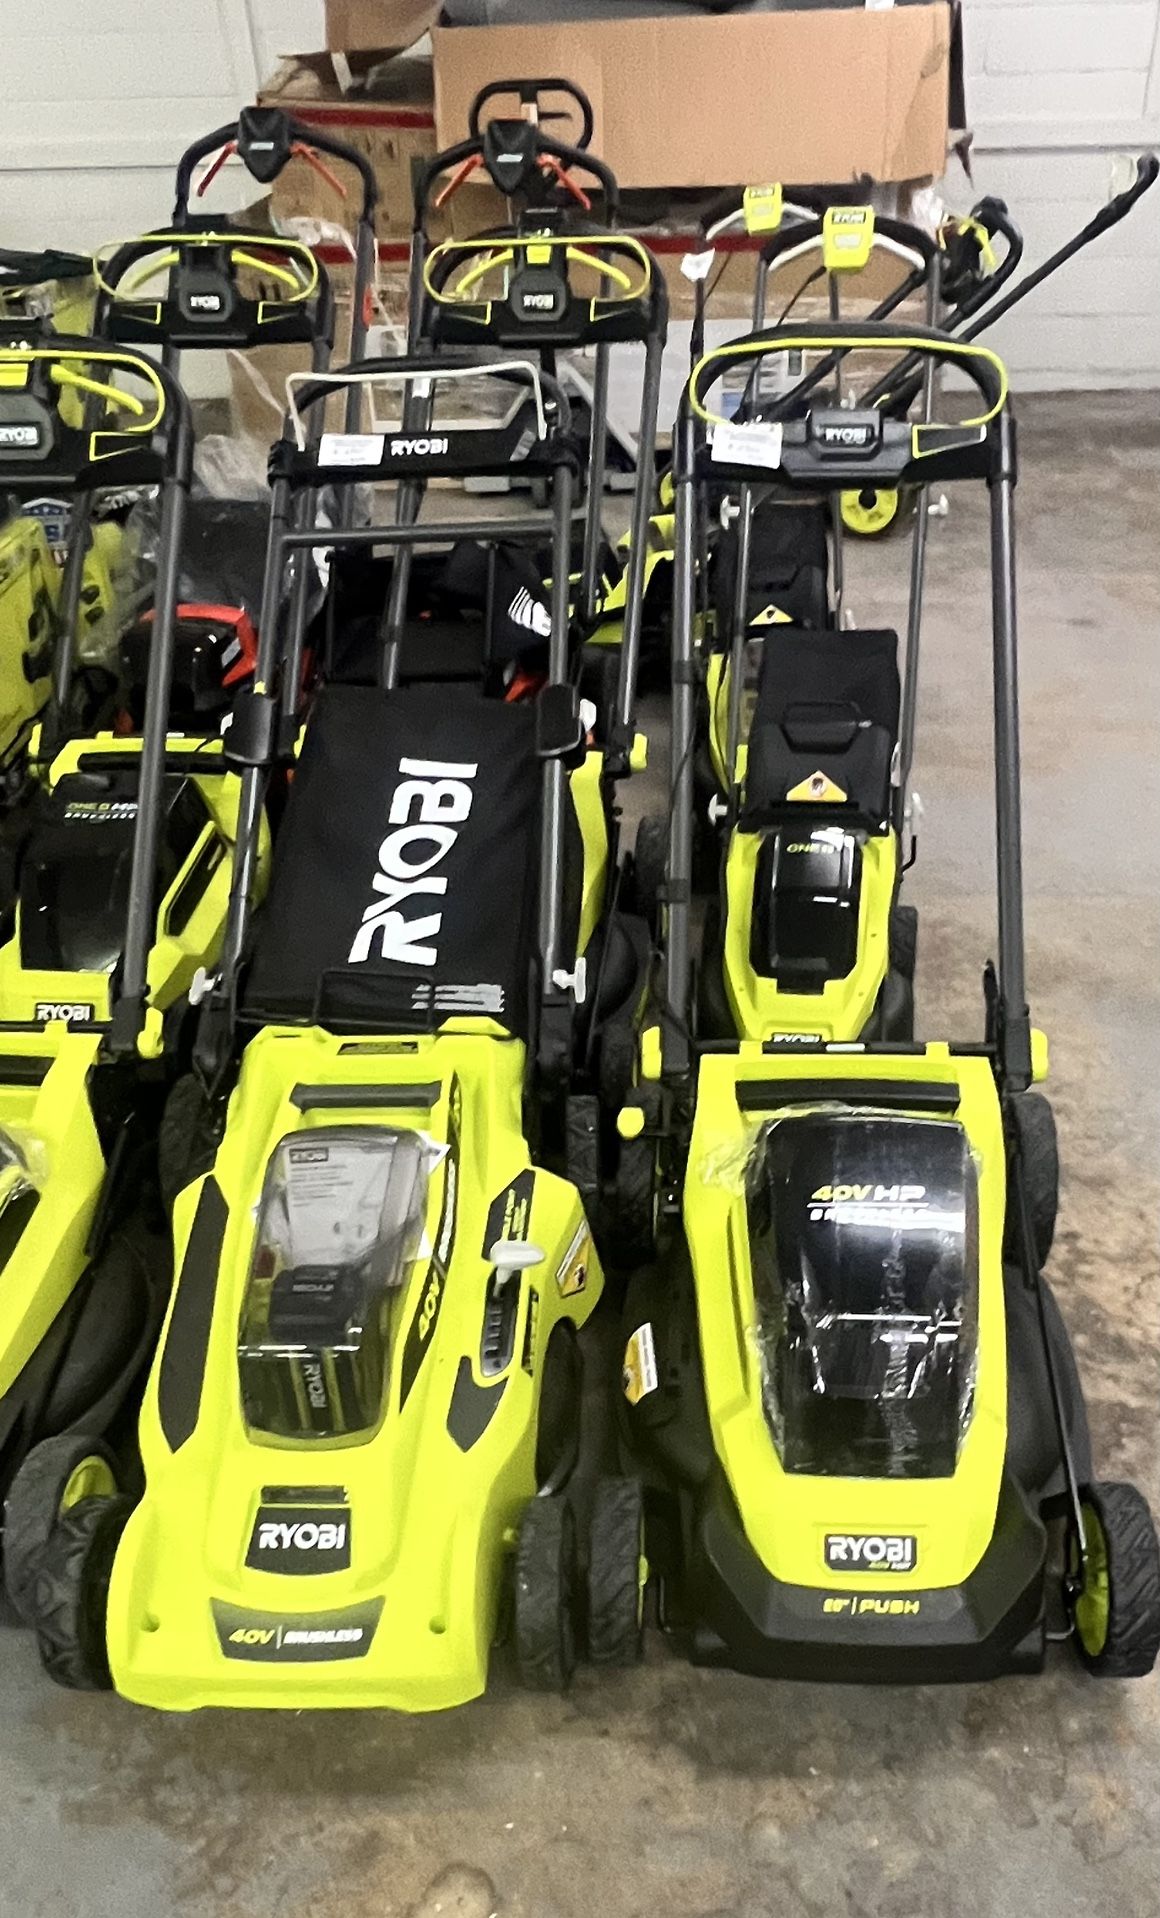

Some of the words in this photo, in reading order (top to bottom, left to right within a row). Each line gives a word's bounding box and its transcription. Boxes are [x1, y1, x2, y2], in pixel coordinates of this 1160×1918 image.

[825, 427, 867, 444] RYOBI
[390, 438, 448, 456] RYOBI
[348, 757, 478, 967] RYOBI
[37, 1004, 90, 1021] RYOBI
[811, 1185, 873, 1201] 40V
[873, 1185, 926, 1201] HP
[303, 1362, 327, 1409] RYOBI
[258, 1522, 346, 1550] RYOBI
[828, 1536, 912, 1562] RYOBI
[859, 1599, 920, 1615] PUSH
[229, 1629, 275, 1644] 40V
